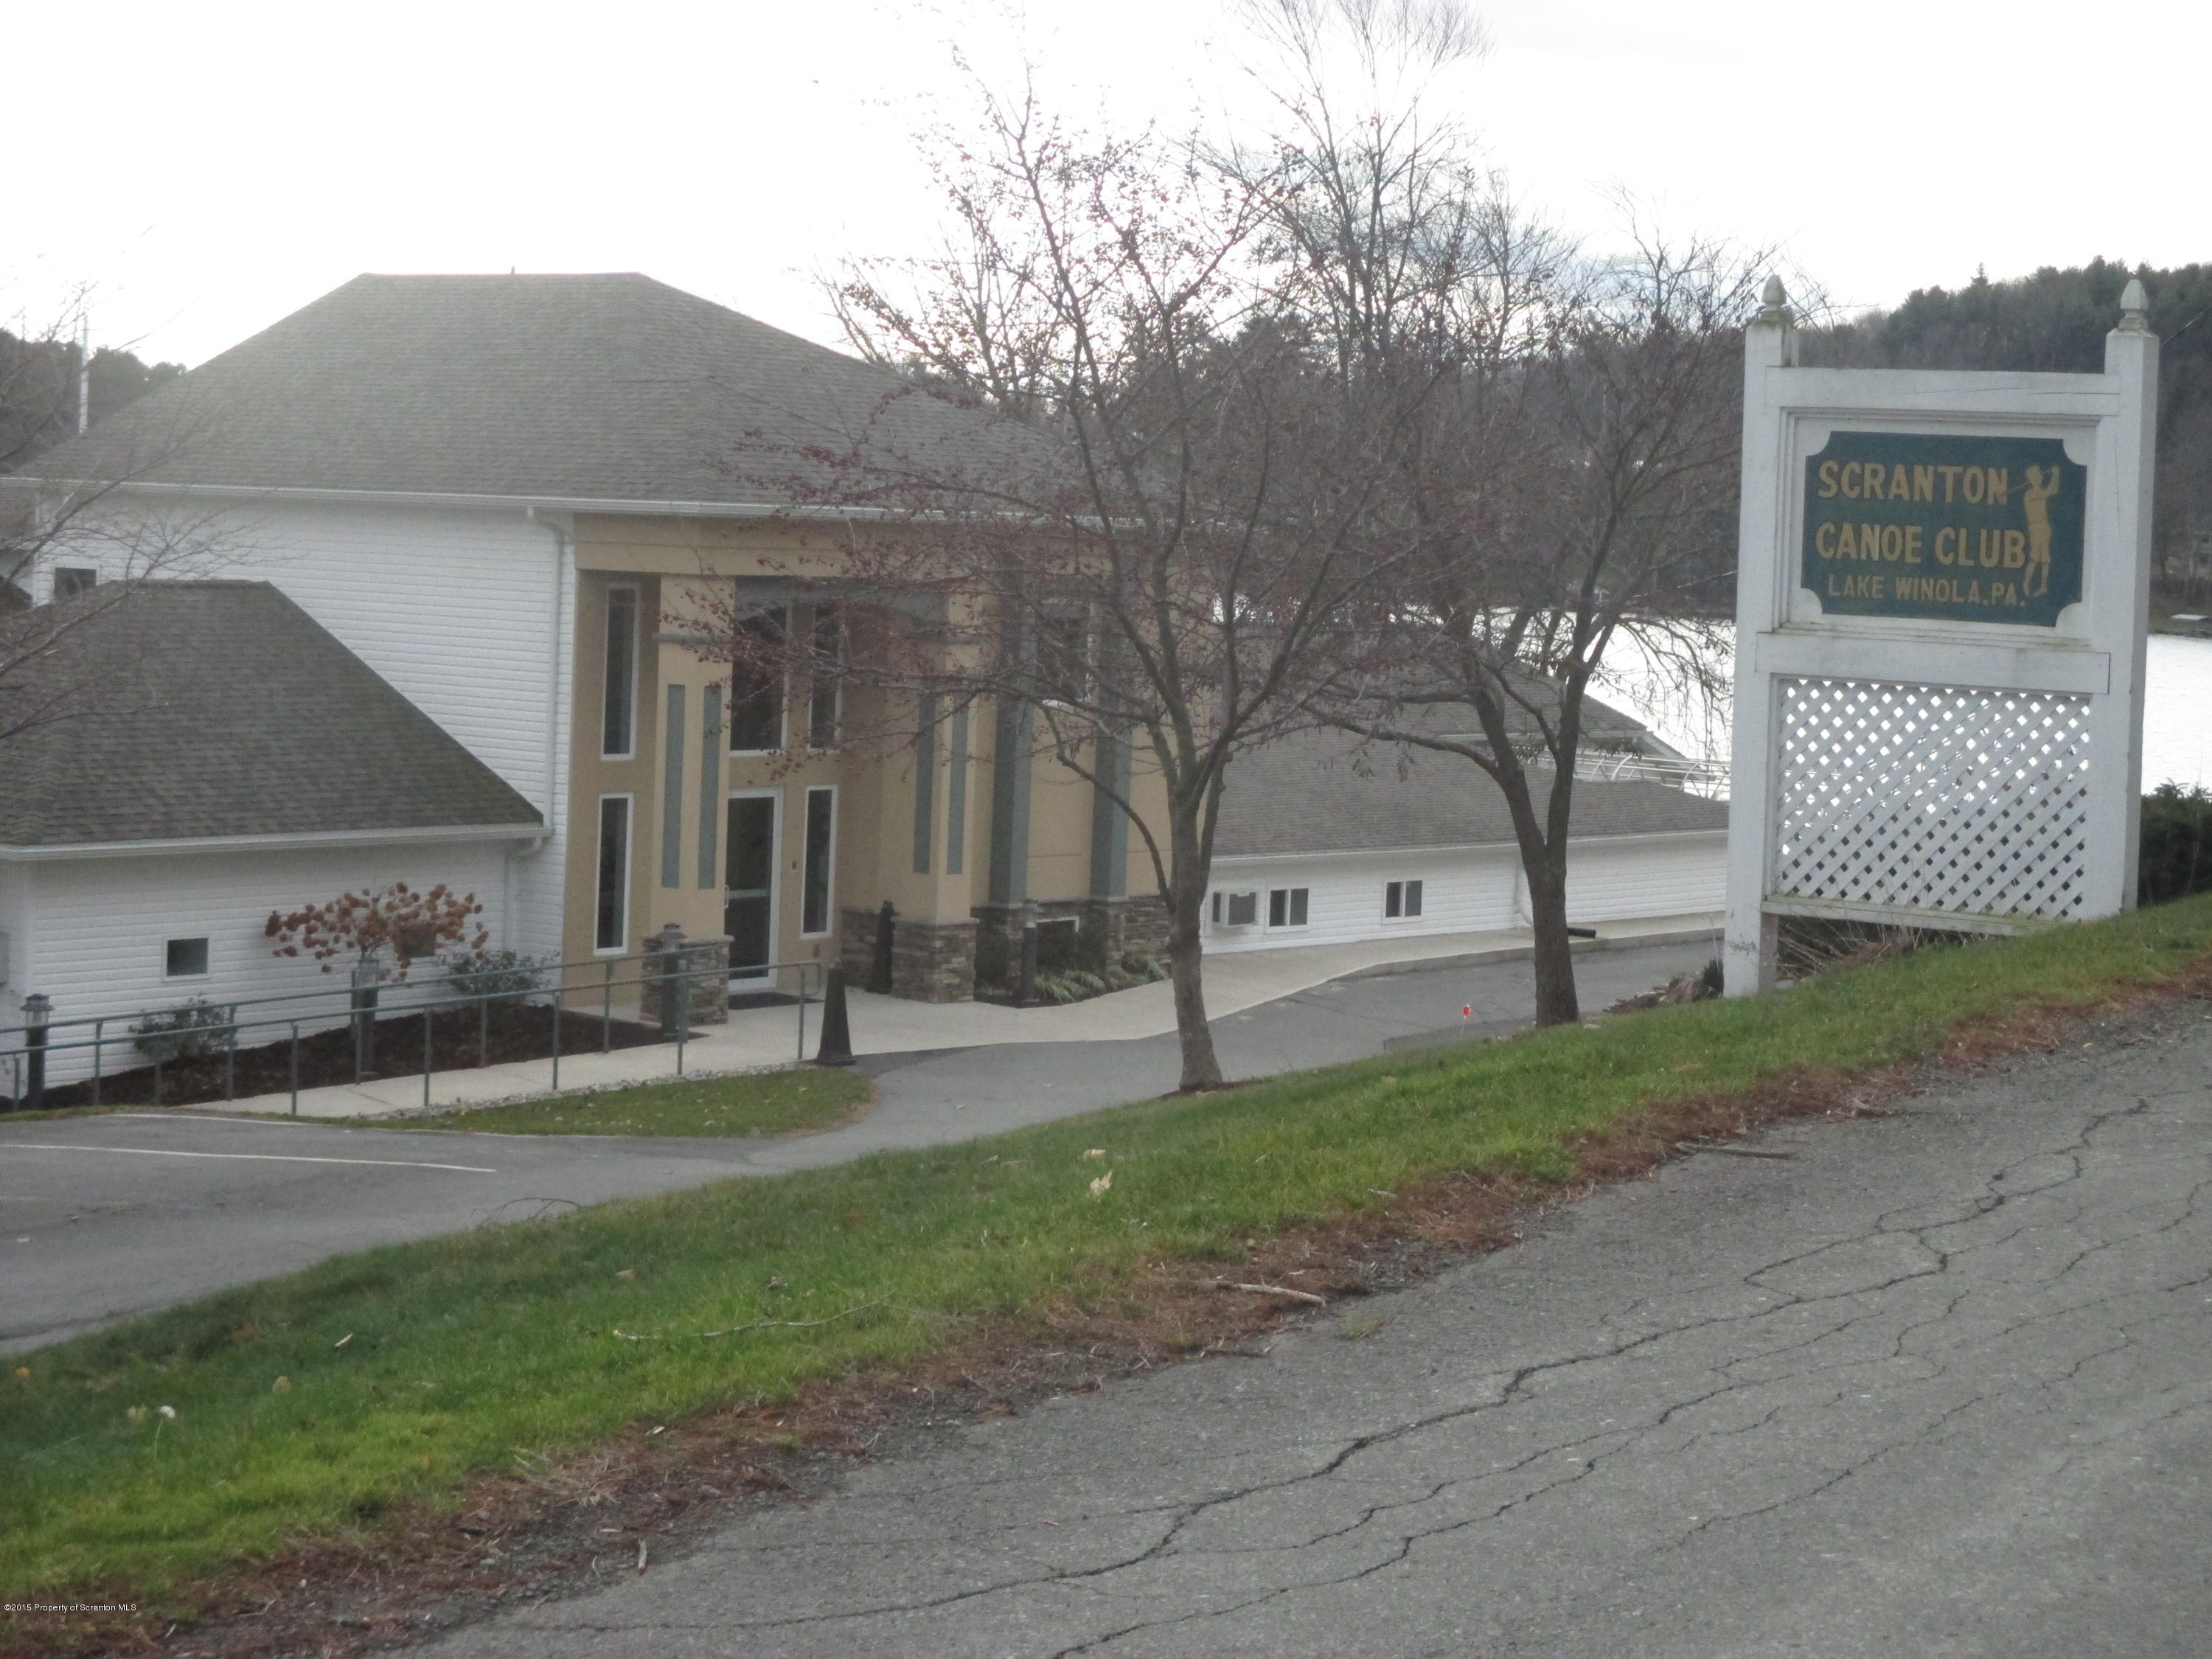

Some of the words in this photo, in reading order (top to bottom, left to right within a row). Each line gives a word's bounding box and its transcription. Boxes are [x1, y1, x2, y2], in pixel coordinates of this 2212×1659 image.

[1818, 459, 2008, 505] SCRANTON
[1815, 521, 1923, 563] CANOE
[1935, 526, 2027, 568] CLUB
[1828, 574, 1885, 599] LAKE
